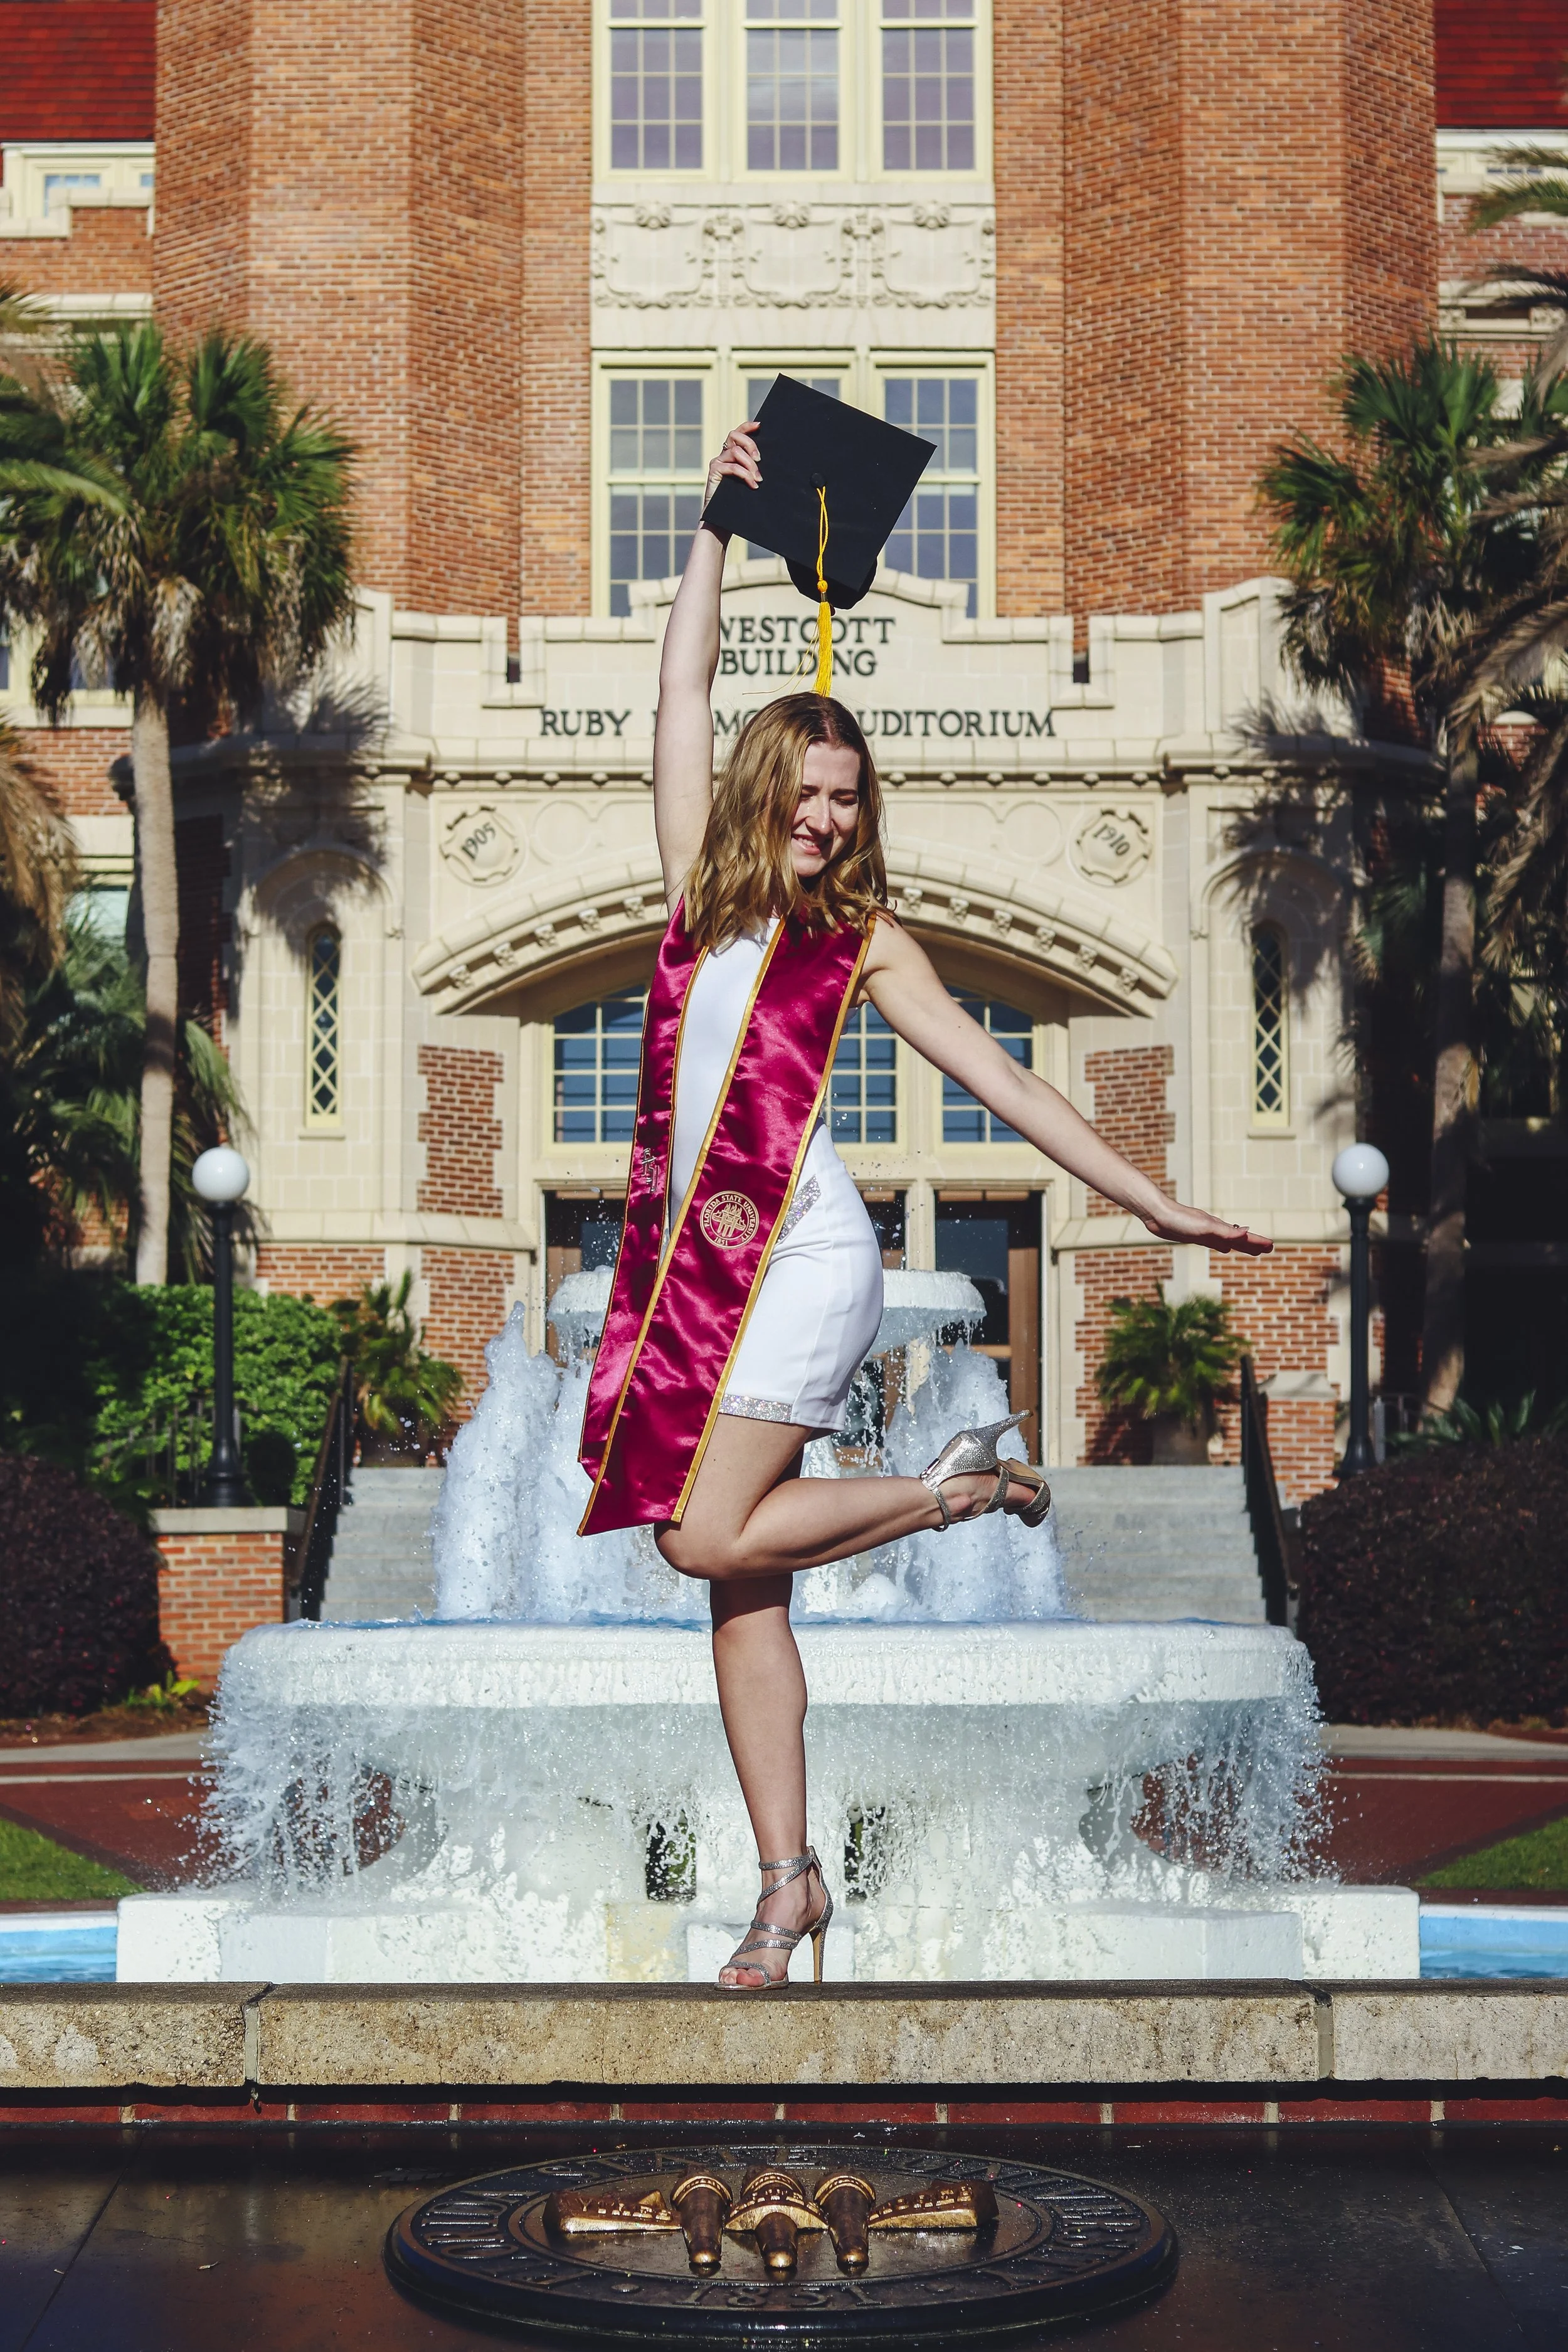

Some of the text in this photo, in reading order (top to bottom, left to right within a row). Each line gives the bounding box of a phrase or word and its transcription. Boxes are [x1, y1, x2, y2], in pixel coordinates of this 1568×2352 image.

[720, 648, 877, 676] BUILDNG
[540, 709, 632, 736] RUBY
[856, 708, 1056, 737] UDITORIUM
[460, 822, 496, 862] 1905
[1092, 823, 1130, 857] 1910
[704, 1194, 756, 1242] FLORIDA STATE UNIVERSITY
[714, 1236, 728, 1246] 1851
[674, 2284, 882, 2307] 1851
